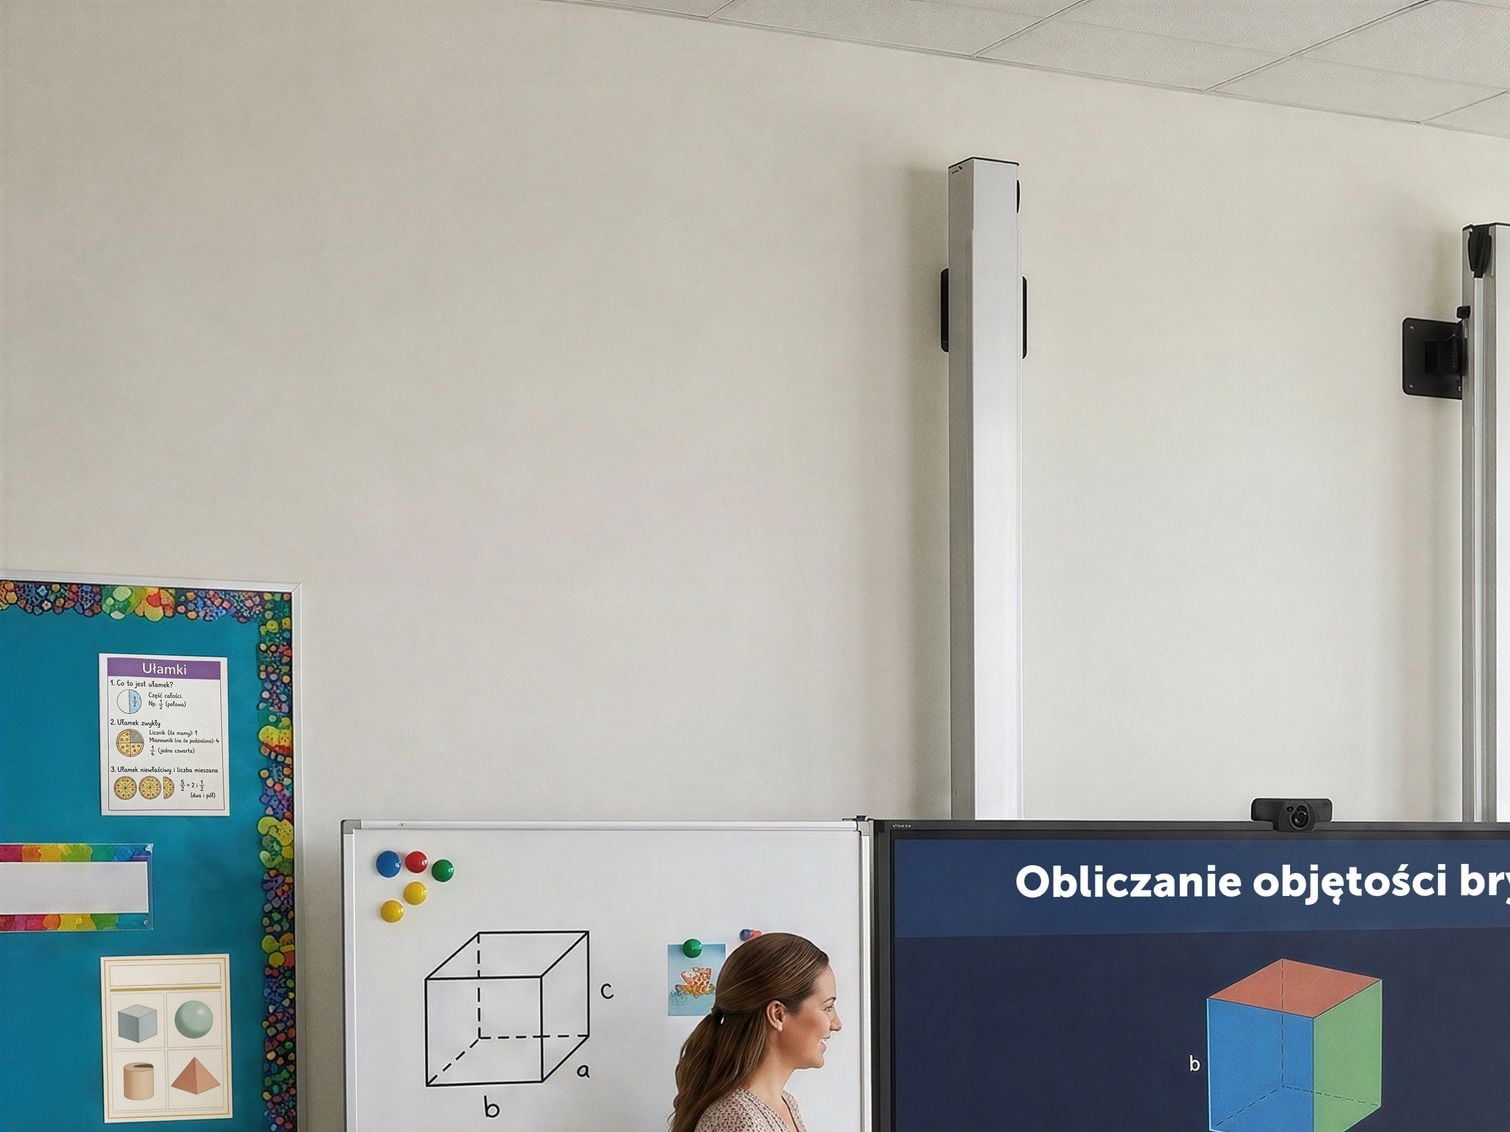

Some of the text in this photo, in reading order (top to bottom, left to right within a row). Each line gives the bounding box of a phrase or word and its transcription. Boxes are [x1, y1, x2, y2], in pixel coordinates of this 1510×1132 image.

[142, 662, 187, 675] Ułamki
[135, 680, 146, 688] jest
[141, 720, 160, 728] zwykły
[140, 766, 172, 775] niewłaściwy
[1016, 864, 1242, 898] Obliczanie
[1253, 863, 1447, 906] objętości
[1189, 1055, 1201, 1071] b
[577, 1065, 590, 1078] a
[484, 1095, 500, 1118] b
